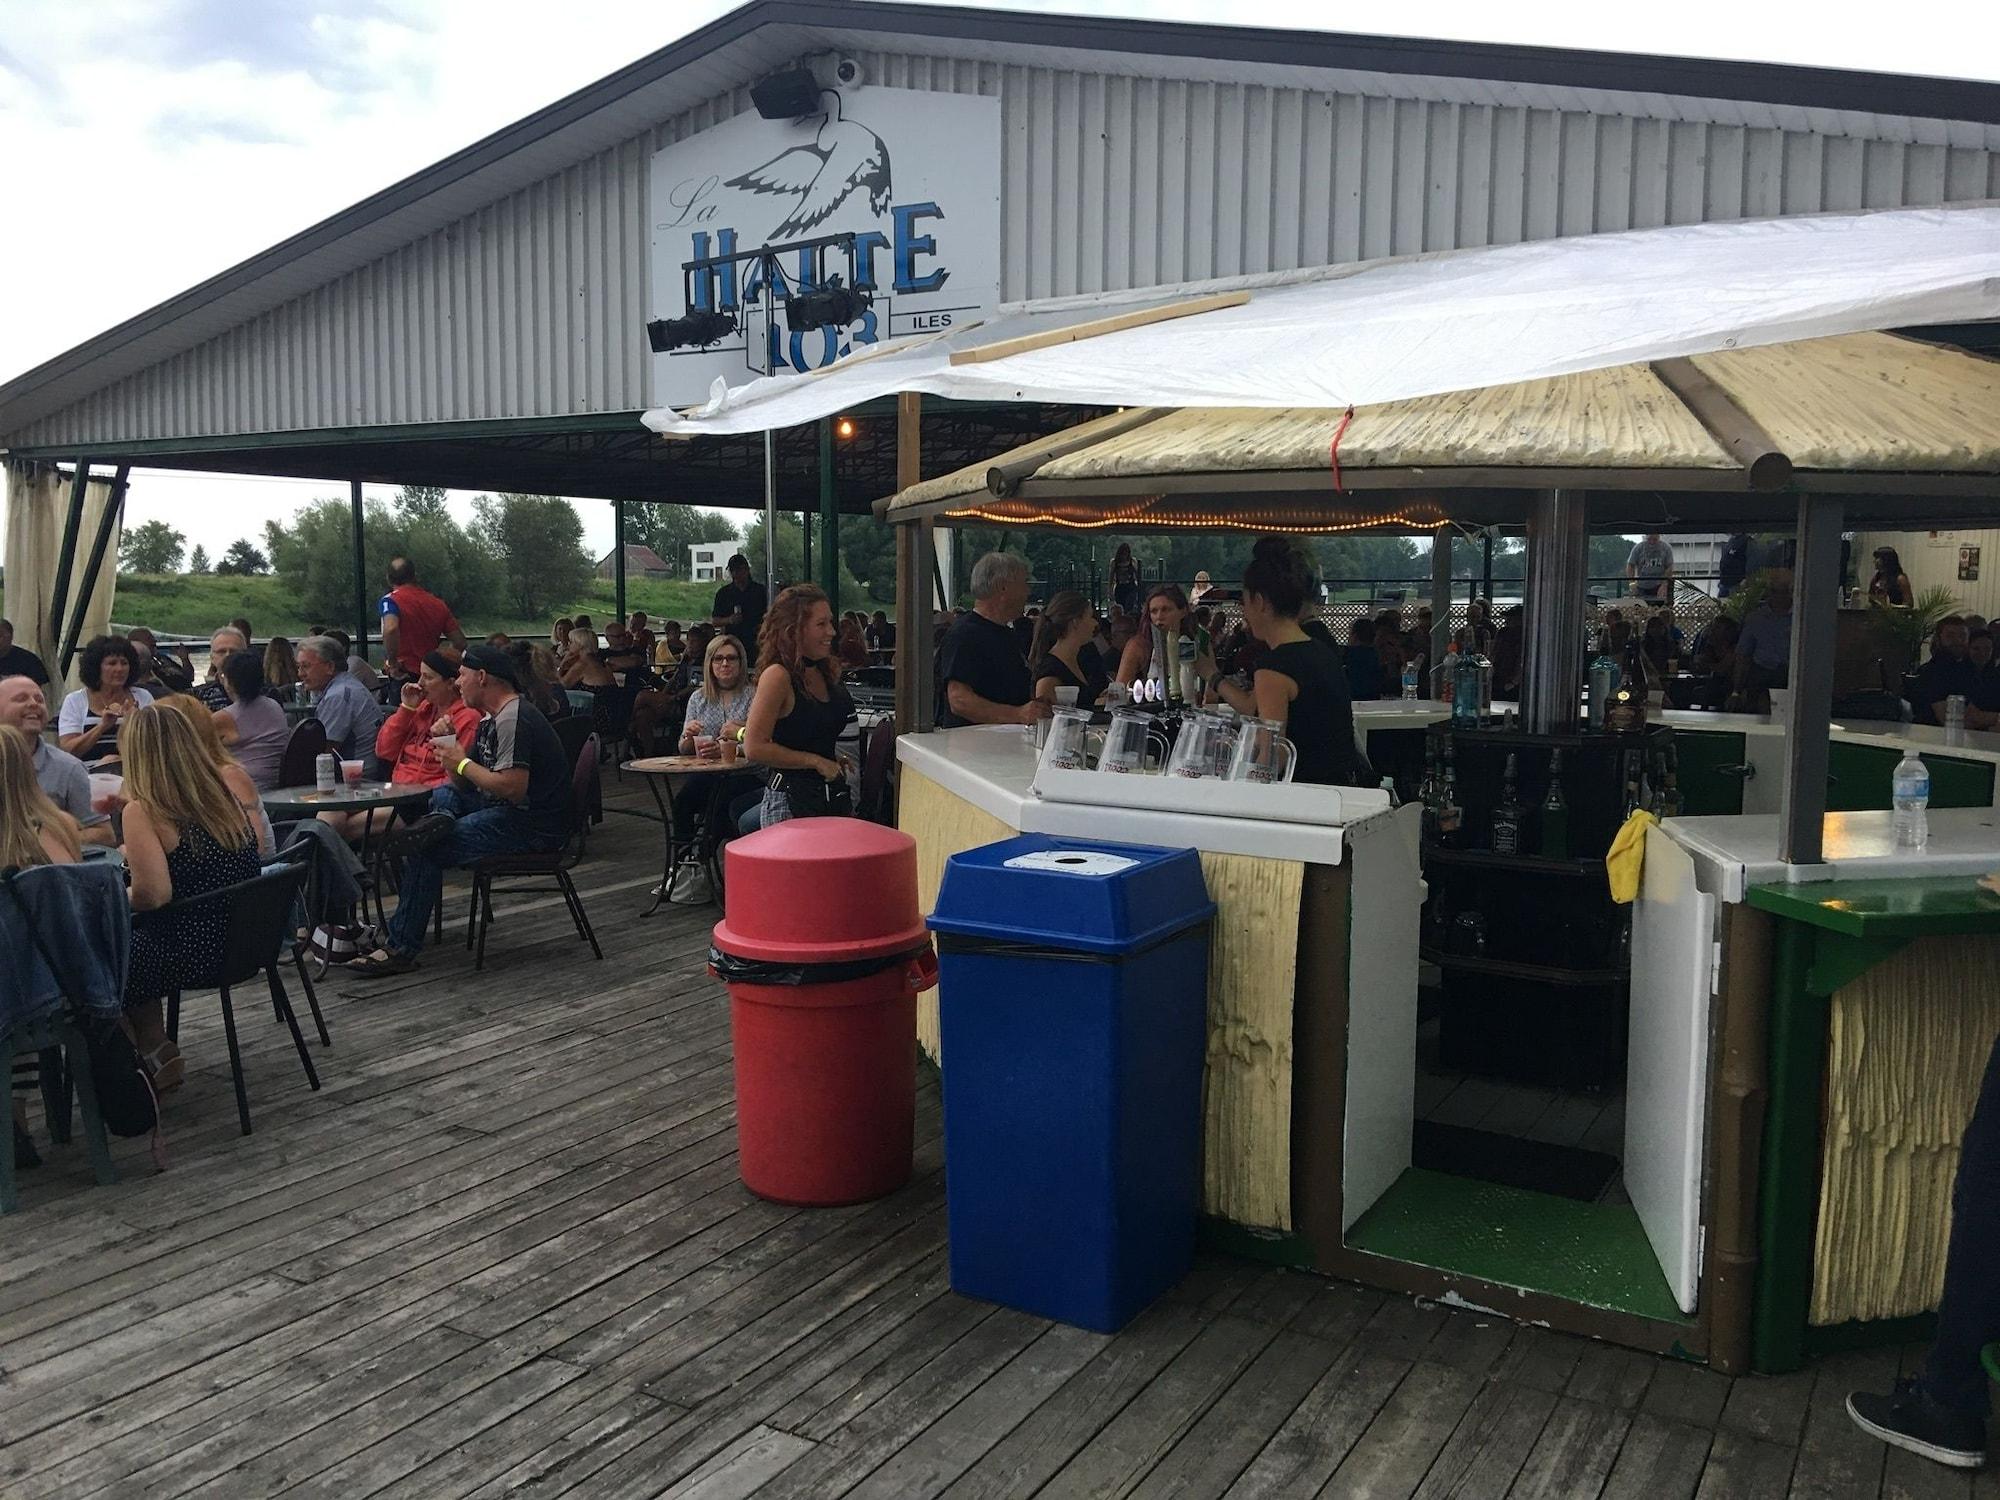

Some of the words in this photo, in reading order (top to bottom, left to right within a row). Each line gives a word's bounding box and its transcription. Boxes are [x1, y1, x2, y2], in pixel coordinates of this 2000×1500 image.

[656, 175, 719, 230] La
[691, 201, 951, 312] HALTE
[913, 314, 952, 329] ILES
